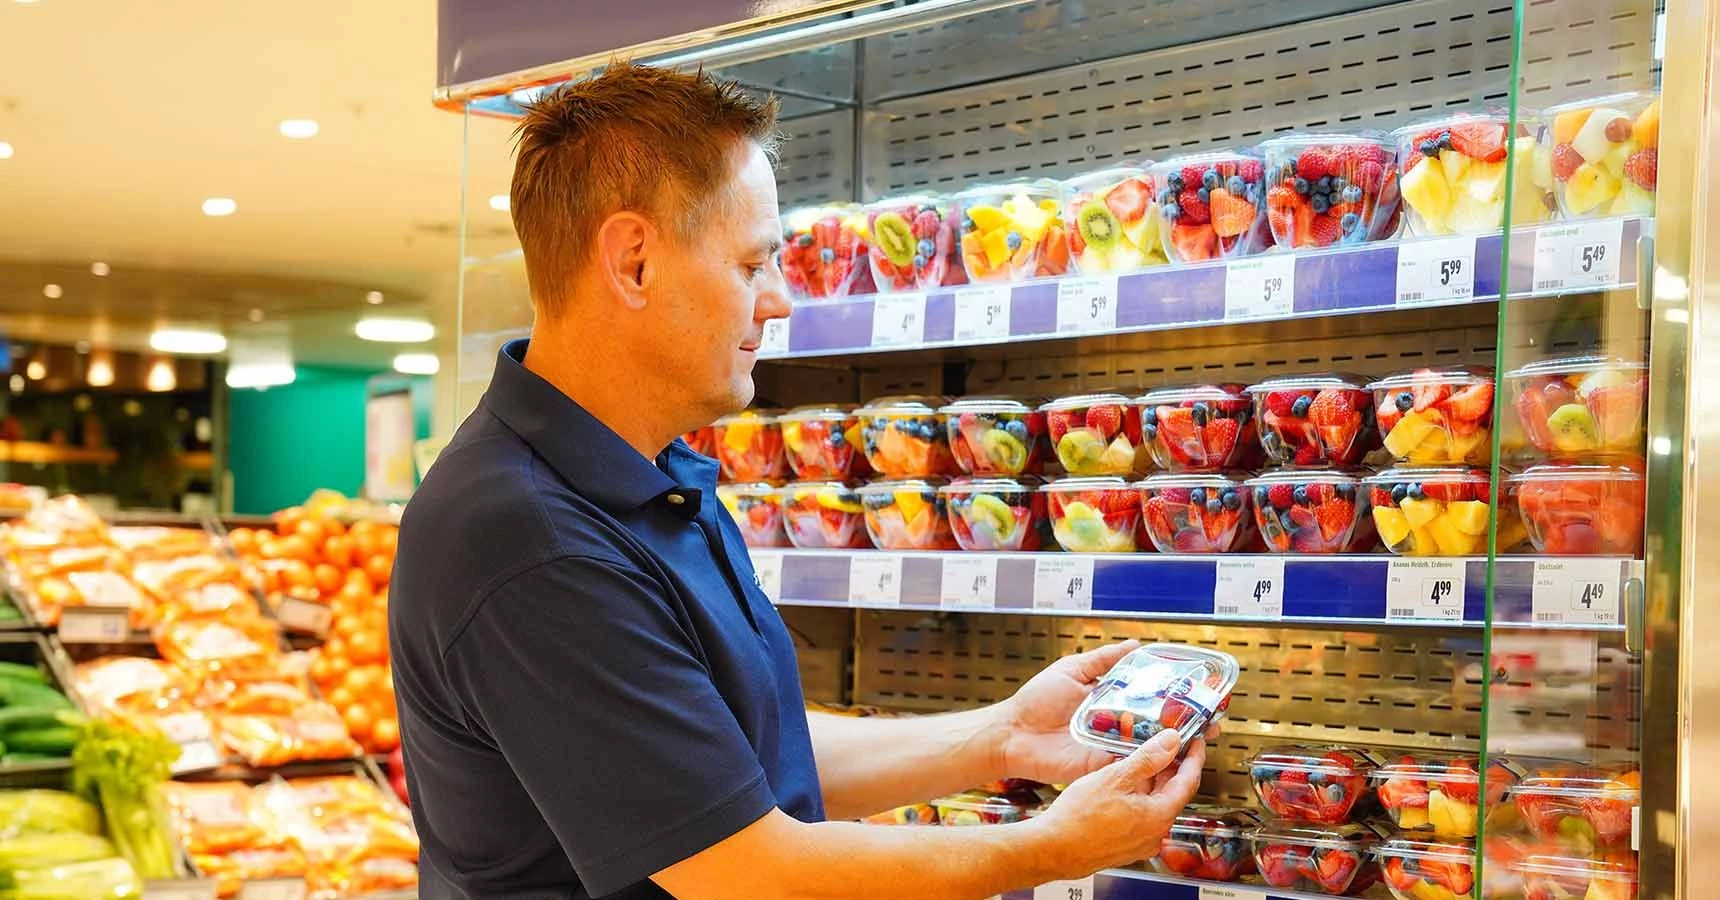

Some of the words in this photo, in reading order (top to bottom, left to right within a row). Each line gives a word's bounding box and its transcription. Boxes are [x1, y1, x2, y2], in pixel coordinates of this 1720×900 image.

[1582, 244, 1605, 273] 549
[1440, 259, 1462, 286] 599
[1263, 277, 1282, 302] 599
[1067, 577, 1083, 599] 499
[1253, 579, 1272, 603] 499
[1431, 580, 1451, 605] 499
[1581, 583, 1604, 609] 449
